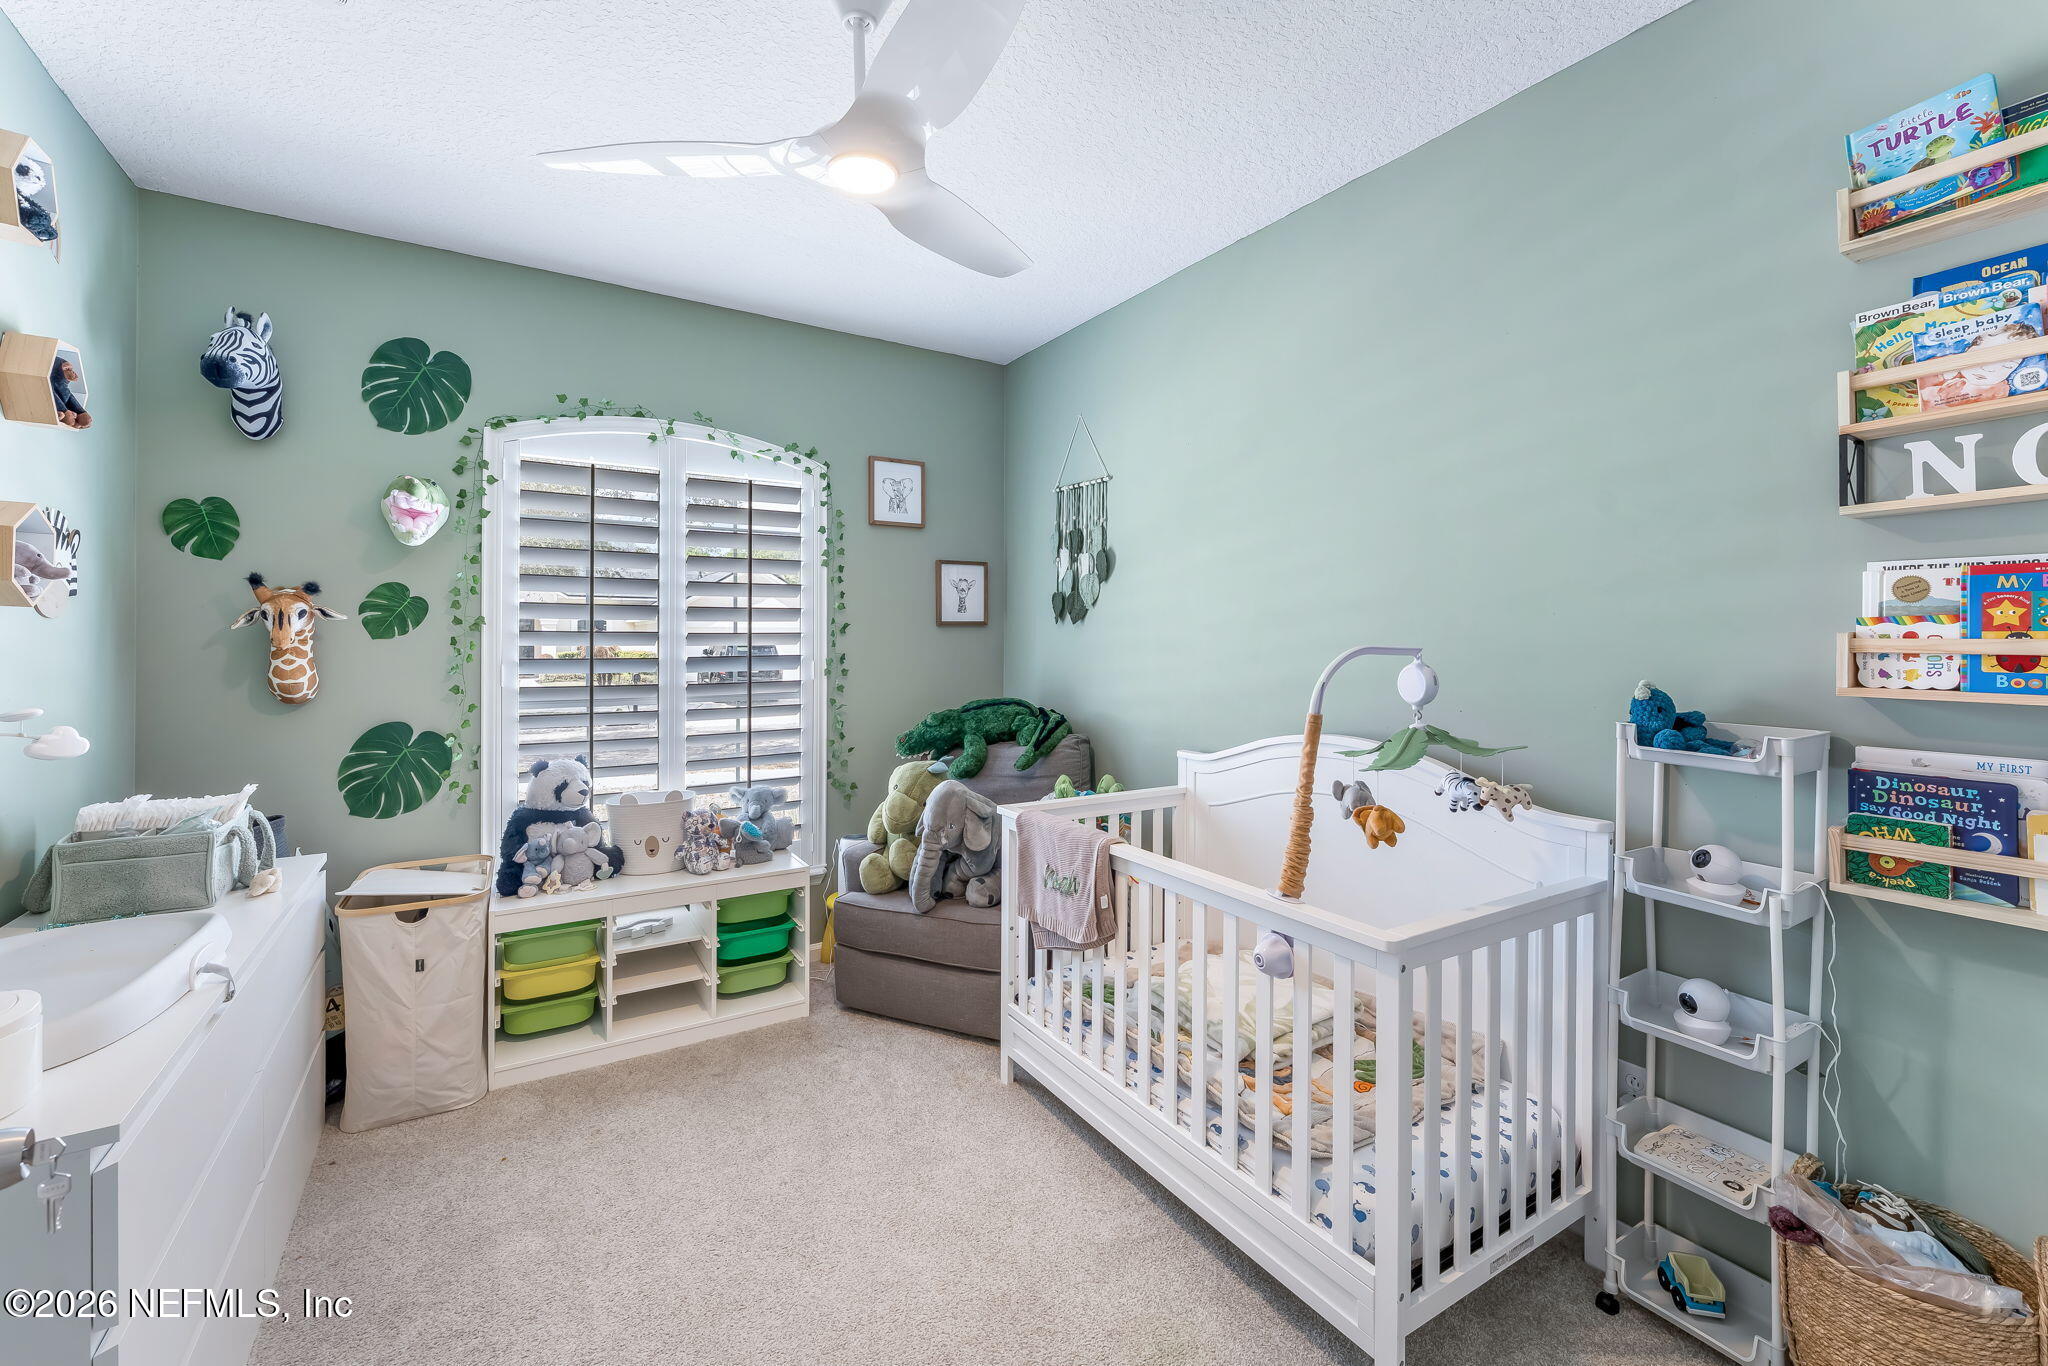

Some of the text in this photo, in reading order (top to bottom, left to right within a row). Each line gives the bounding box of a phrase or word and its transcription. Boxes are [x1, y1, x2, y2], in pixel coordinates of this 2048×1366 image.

[1867, 102, 1975, 158] TURTLE
[1899, 109, 1934, 128] Little
[1981, 256, 2028, 278] OCEAN
[1943, 277, 2030, 304] Brown Bear,
[1858, 299, 1936, 323] Brown Bear,
[1935, 324, 1970, 339] sleep
[1975, 312, 2013, 328] baby
[1874, 330, 1914, 352] Hello
[1996, 574, 2033, 591] My
[1976, 761, 2033, 775] MY FIRST
[1875, 775, 1981, 800] Dinosaur,
[1872, 789, 1985, 815] Dinosaur,
[1860, 802, 2001, 831] Say Good Night
